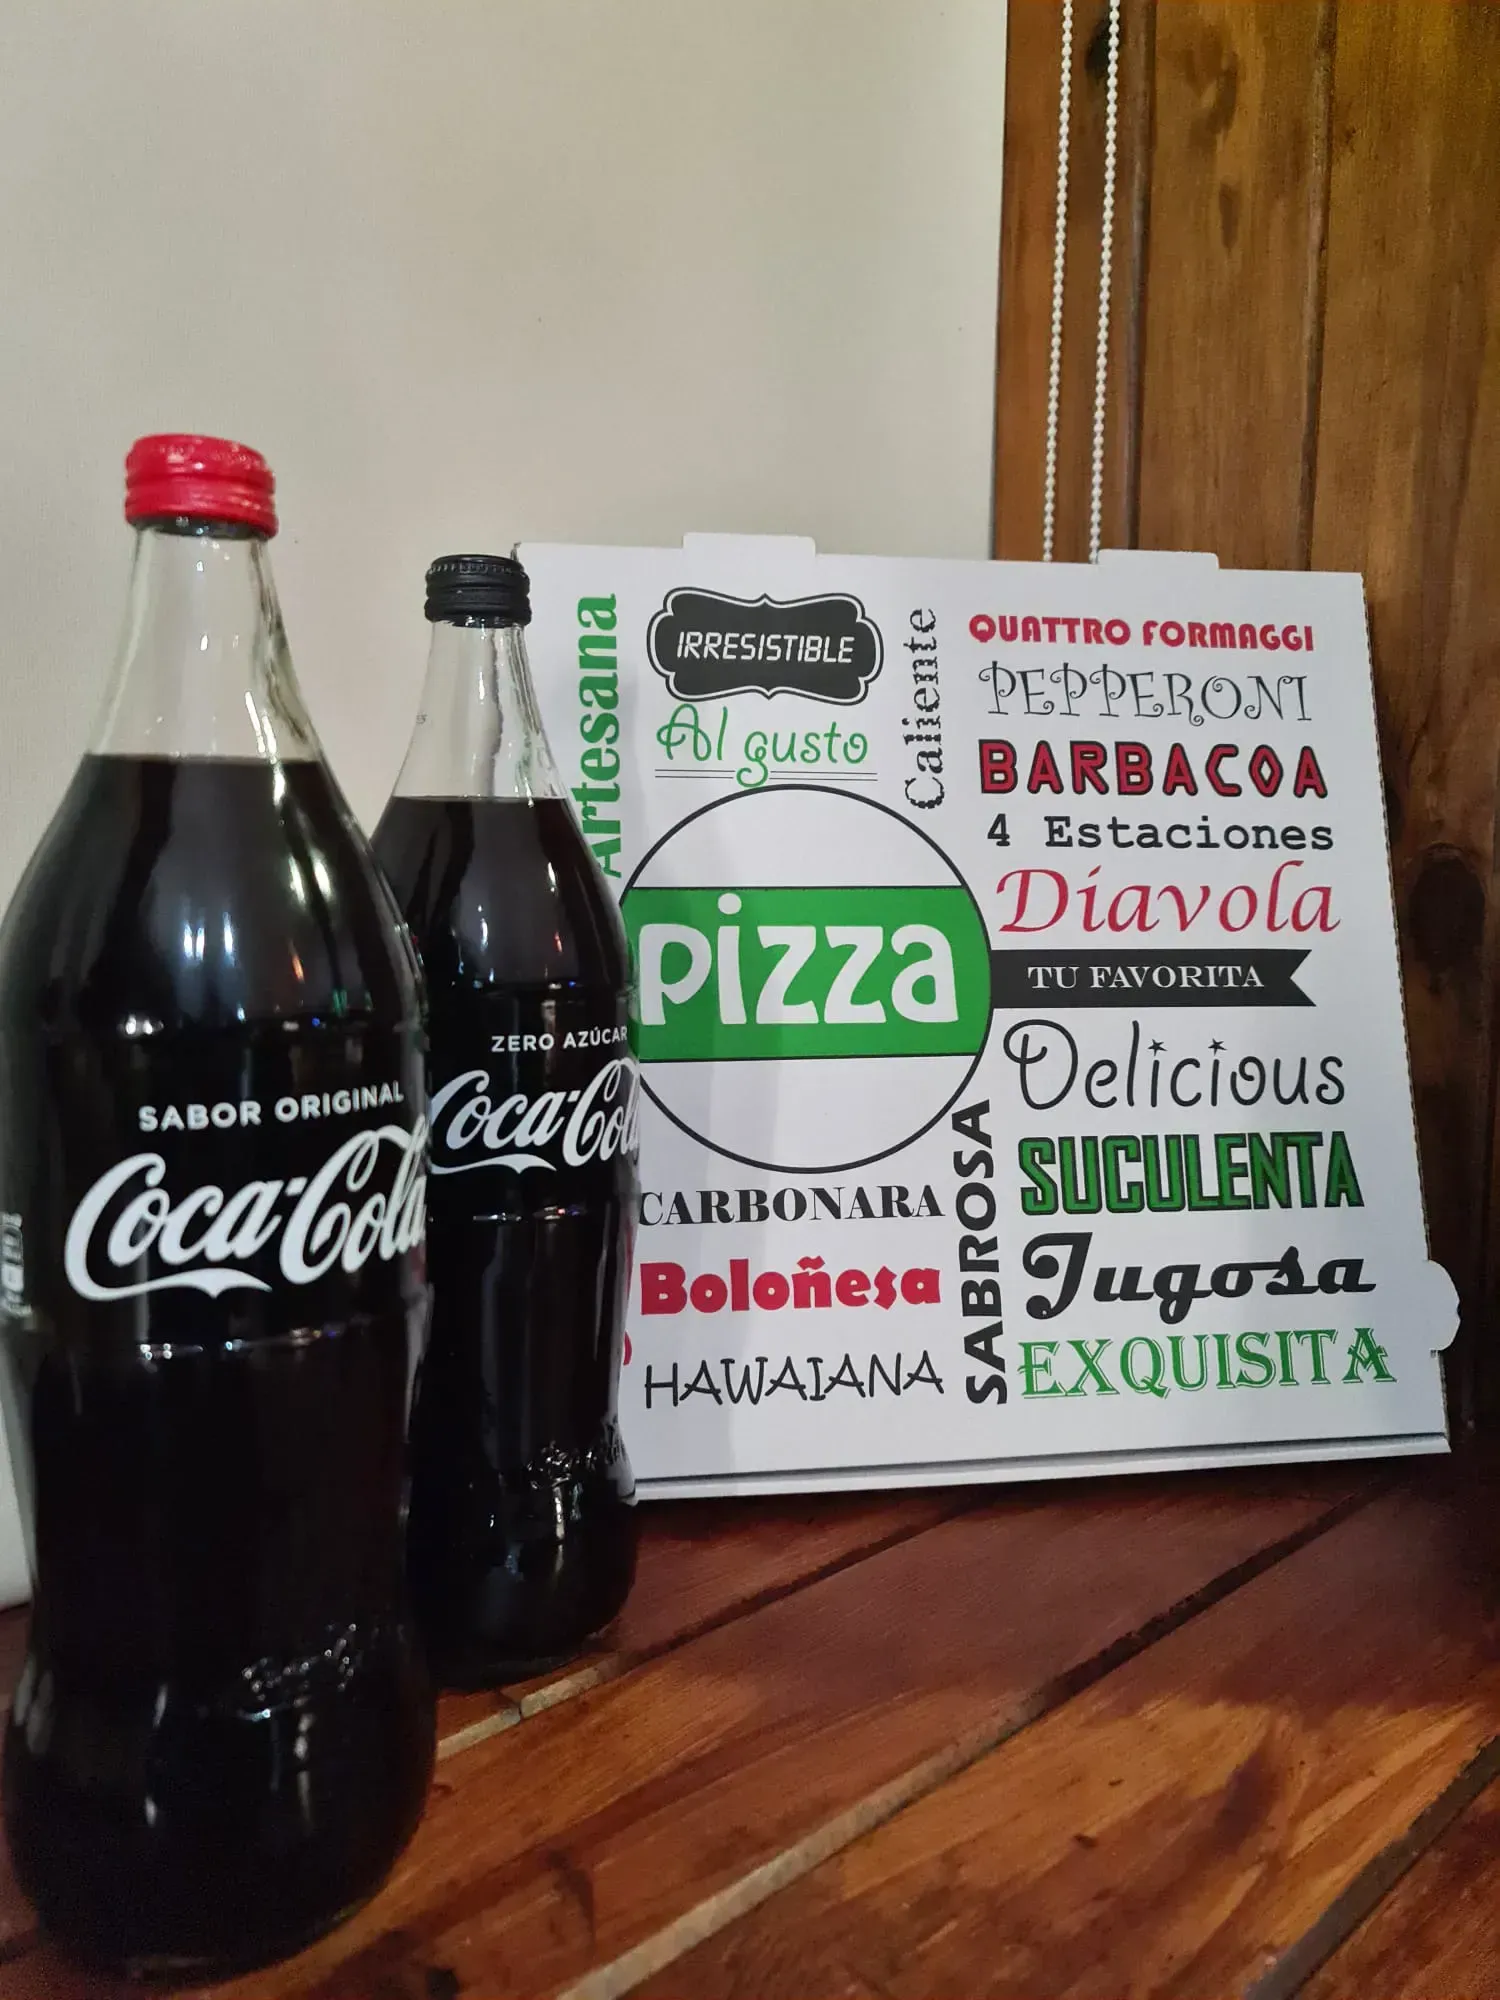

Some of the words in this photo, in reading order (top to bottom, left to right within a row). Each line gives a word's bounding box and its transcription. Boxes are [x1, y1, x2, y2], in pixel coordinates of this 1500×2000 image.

[677, 631, 855, 664] IRRESISTIBLE
[968, 614, 1132, 646] QUATTRO
[1142, 619, 1314, 652] FORMAGGI
[902, 608, 945, 810] Caliente
[978, 660, 1313, 727] PEPPERONI
[571, 593, 622, 878] Artesana
[656, 703, 730, 762] Al
[736, 721, 869, 788] gusto
[977, 738, 1329, 799] BARBACOA
[986, 812, 1011, 848] 4
[1044, 815, 1334, 850] Estaciones
[638, 892, 960, 1026] pizza
[1027, 965, 1080, 990] TU
[1090, 965, 1266, 990] FAVORITA
[491, 1033, 555, 1053] ZERO
[563, 1024, 628, 1050] AZÚCAR
[1003, 1018, 1346, 1111] Delicious
[138, 1101, 262, 1133] SABOR
[274, 1081, 405, 1124] ORIGINAL
[639, 1184, 946, 1226] CARBONARA
[1018, 1130, 1366, 1216] SUCULENTA
[65, 1113, 427, 1301] Coca-Cola
[640, 1255, 941, 1316] Boloñesa
[952, 1099, 1007, 1405] SABROSA
[1022, 1231, 1377, 1325] Jugosa
[644, 1350, 945, 1409] HAWAIANA
[1017, 1327, 1397, 1399] EXQUISITA
